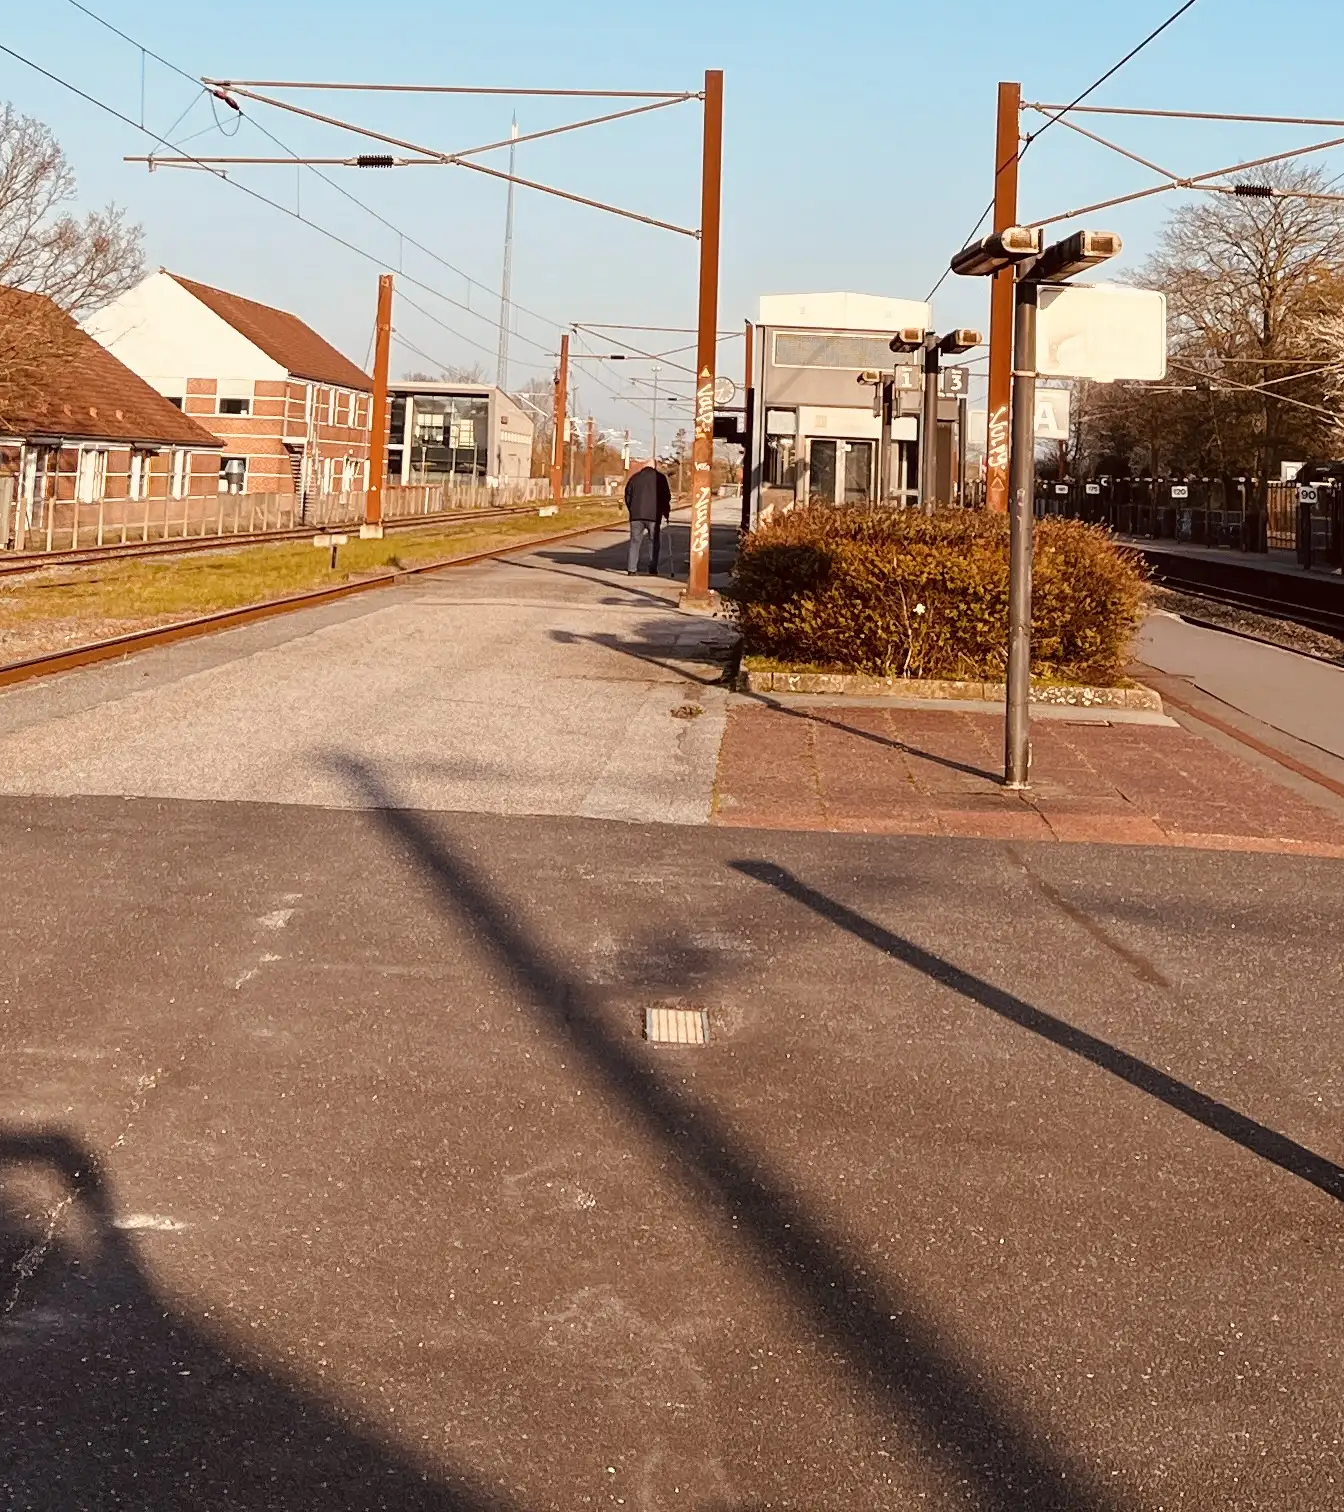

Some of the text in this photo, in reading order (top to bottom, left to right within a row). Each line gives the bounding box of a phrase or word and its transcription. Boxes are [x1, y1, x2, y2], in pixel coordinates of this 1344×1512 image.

[901, 372, 912, 388] 1
[950, 374, 962, 390] 3
[1034, 400, 1060, 431] A
[1301, 489, 1316, 500] 90
